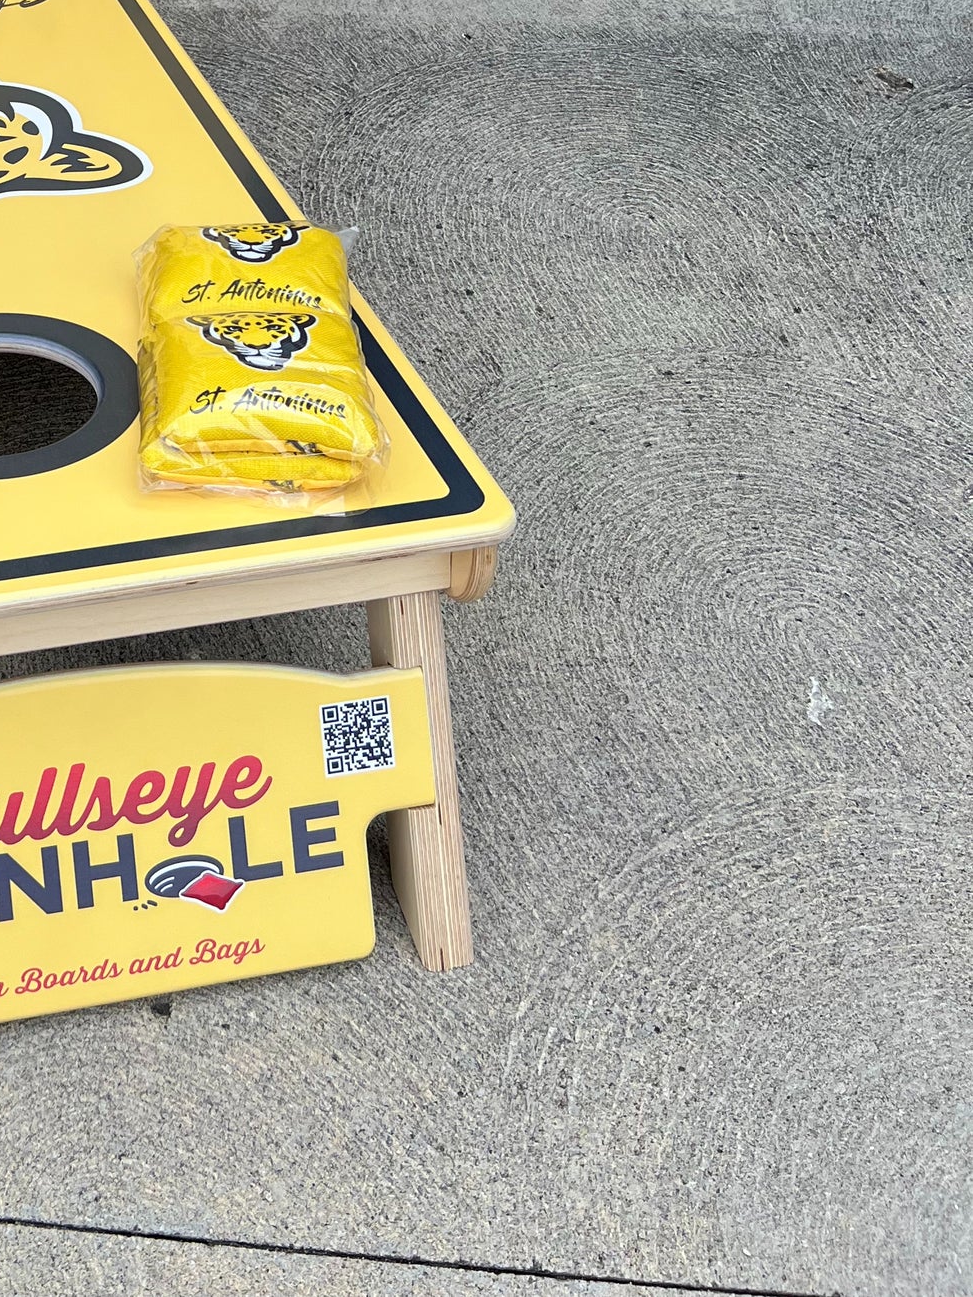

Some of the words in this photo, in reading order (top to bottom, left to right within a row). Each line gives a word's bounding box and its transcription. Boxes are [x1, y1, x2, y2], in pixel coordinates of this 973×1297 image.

[181, 279, 215, 304] St.
[220, 277, 322, 308] Antoninus
[189, 386, 225, 415] St.
[232, 386, 347, 420] Antoninus
[14, 956, 124, 997] Boards
[128, 946, 184, 976] and
[188, 936, 267, 968] Bags
